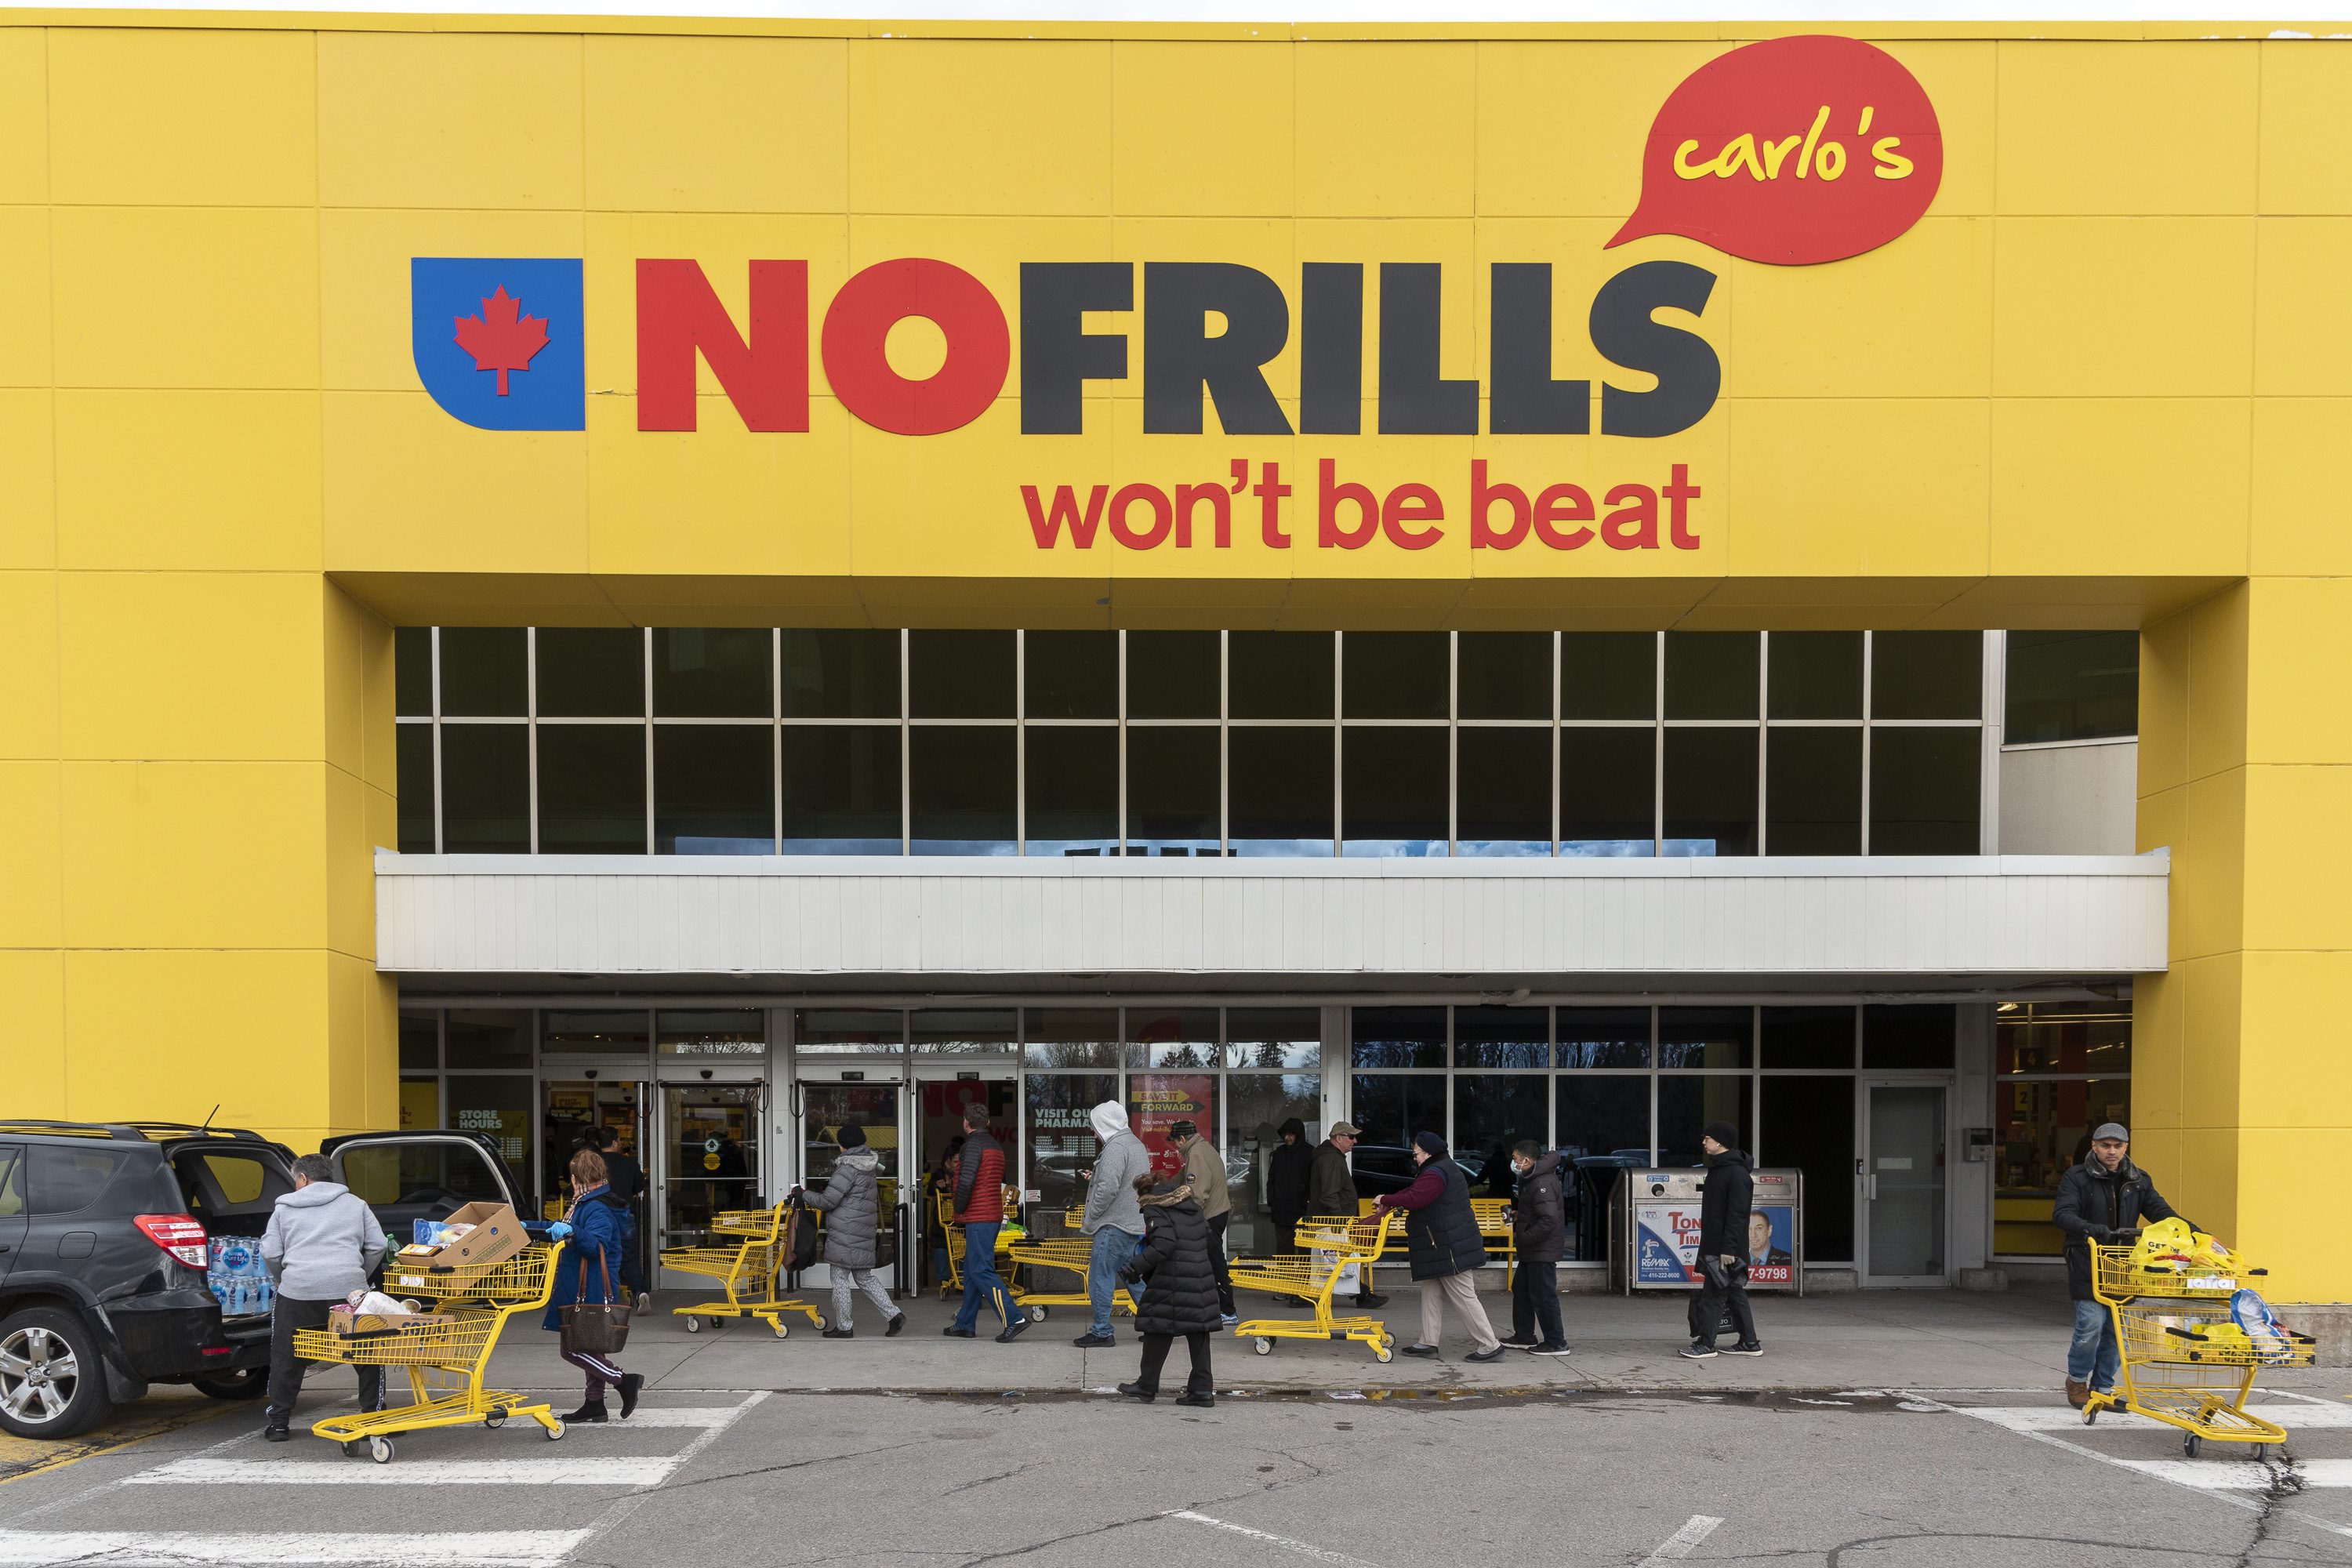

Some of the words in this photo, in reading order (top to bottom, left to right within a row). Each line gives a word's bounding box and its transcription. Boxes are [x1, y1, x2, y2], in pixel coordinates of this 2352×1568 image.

[1673, 105, 1914, 181] carlo's
[1020, 458, 1292, 551] won't
[1318, 458, 1444, 550] be
[1470, 459, 1701, 551] beat
[1141, 1092, 1167, 1101] SAVE
[1169, 1092, 1178, 1101] IT
[2020, 1091, 2028, 1105] 2
[459, 1109, 498, 1120] STORE
[1035, 1109, 1067, 1118] VISIT
[1072, 1109, 1091, 1118] OU
[459, 1119, 503, 1129] HOURS
[1035, 1118, 1091, 1127] PHARMA
[1668, 1211, 1702, 1230] TON
[1676, 1231, 1700, 1246] TIM
[2147, 1241, 2166, 1250] GET
[1642, 1258, 1670, 1267] RE/MAX
